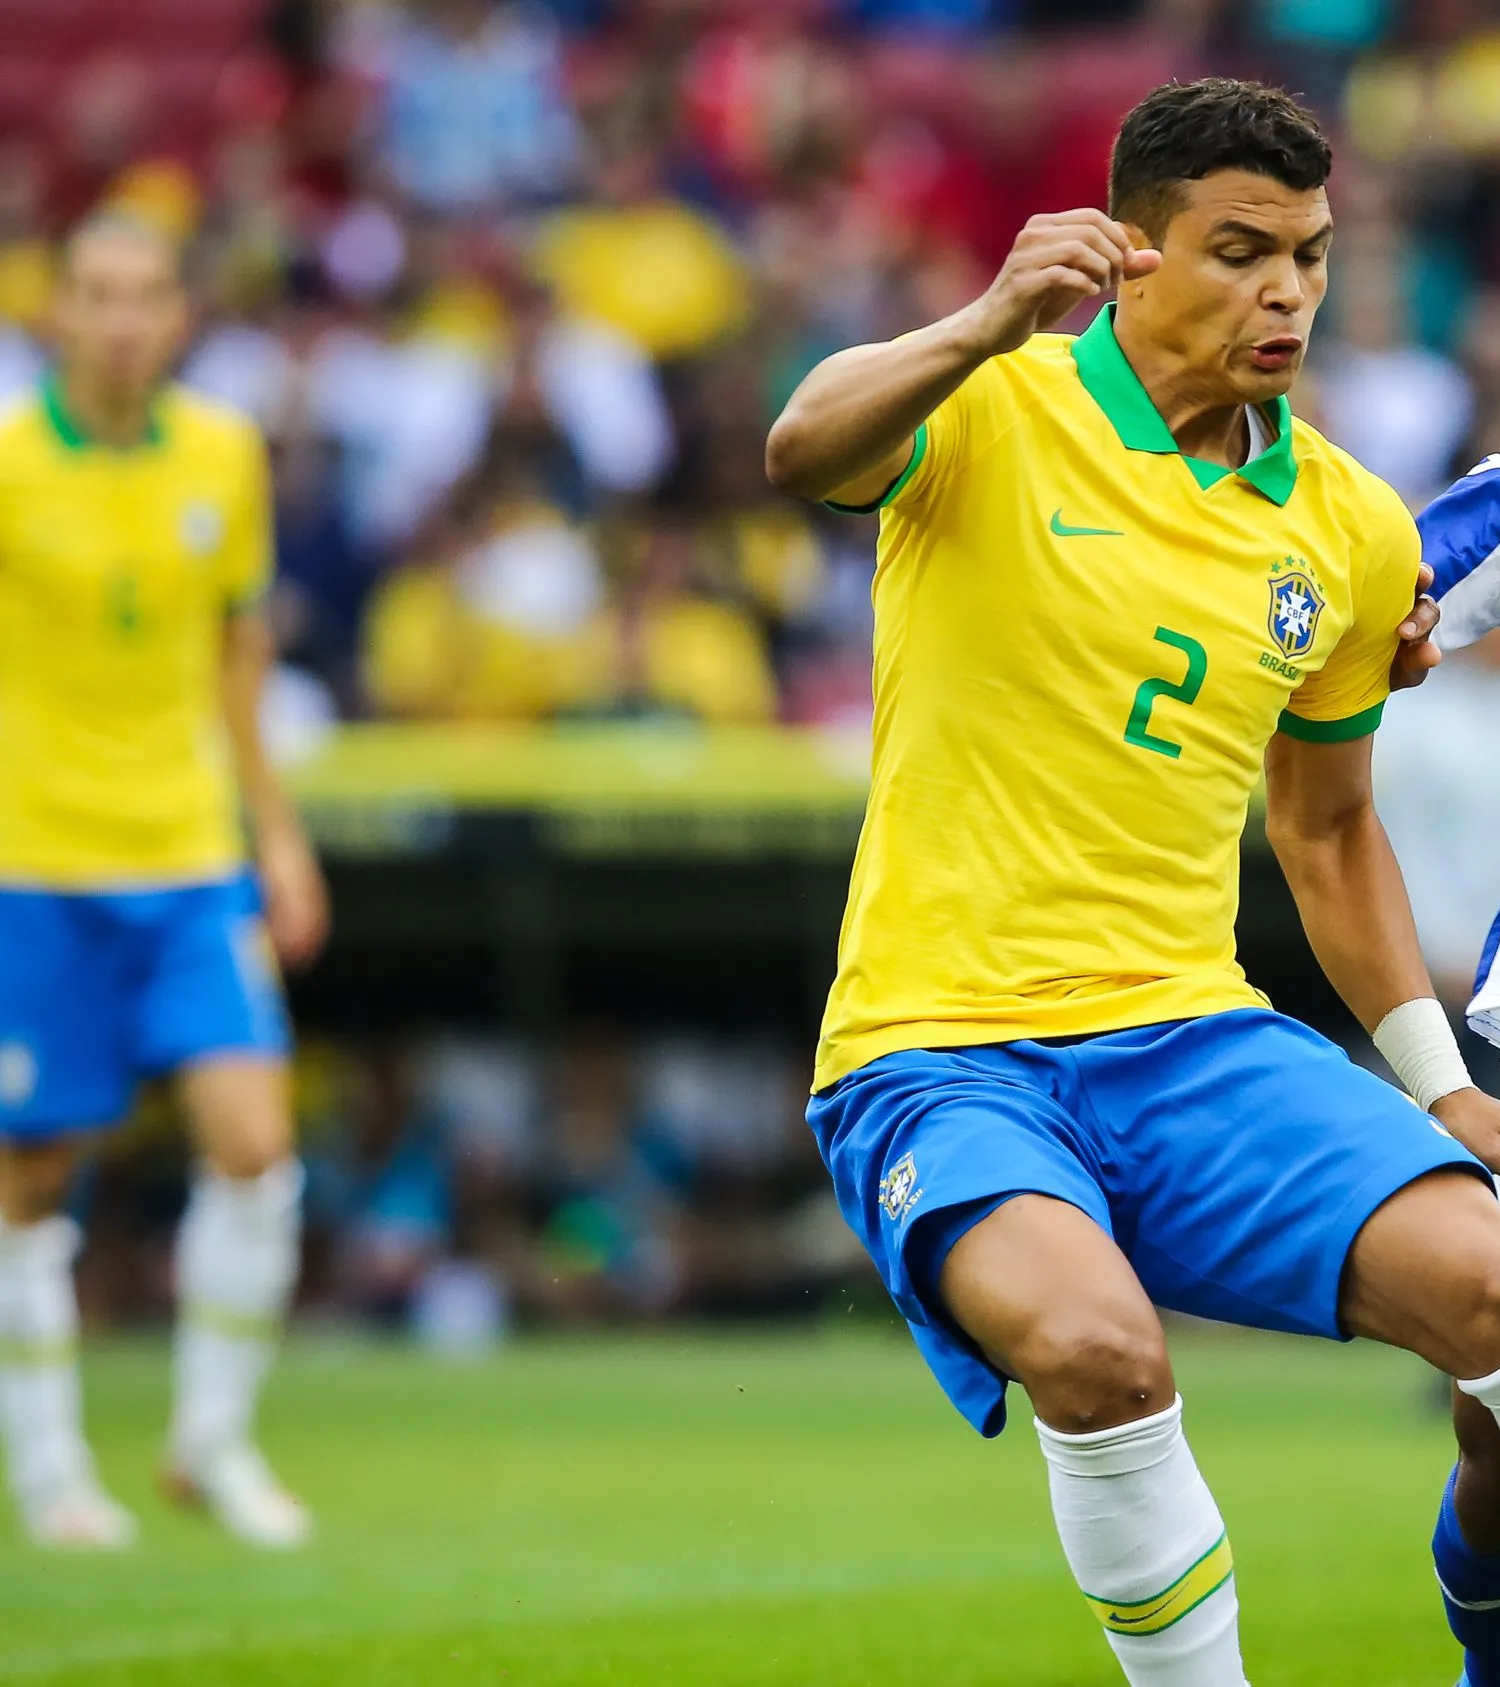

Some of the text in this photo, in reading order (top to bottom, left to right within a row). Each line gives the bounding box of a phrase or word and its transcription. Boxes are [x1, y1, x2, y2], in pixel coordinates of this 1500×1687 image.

[1286, 606, 1305, 620] CBF
[1259, 651, 1301, 680] BRASIL
[1124, 626, 1207, 759] 2
